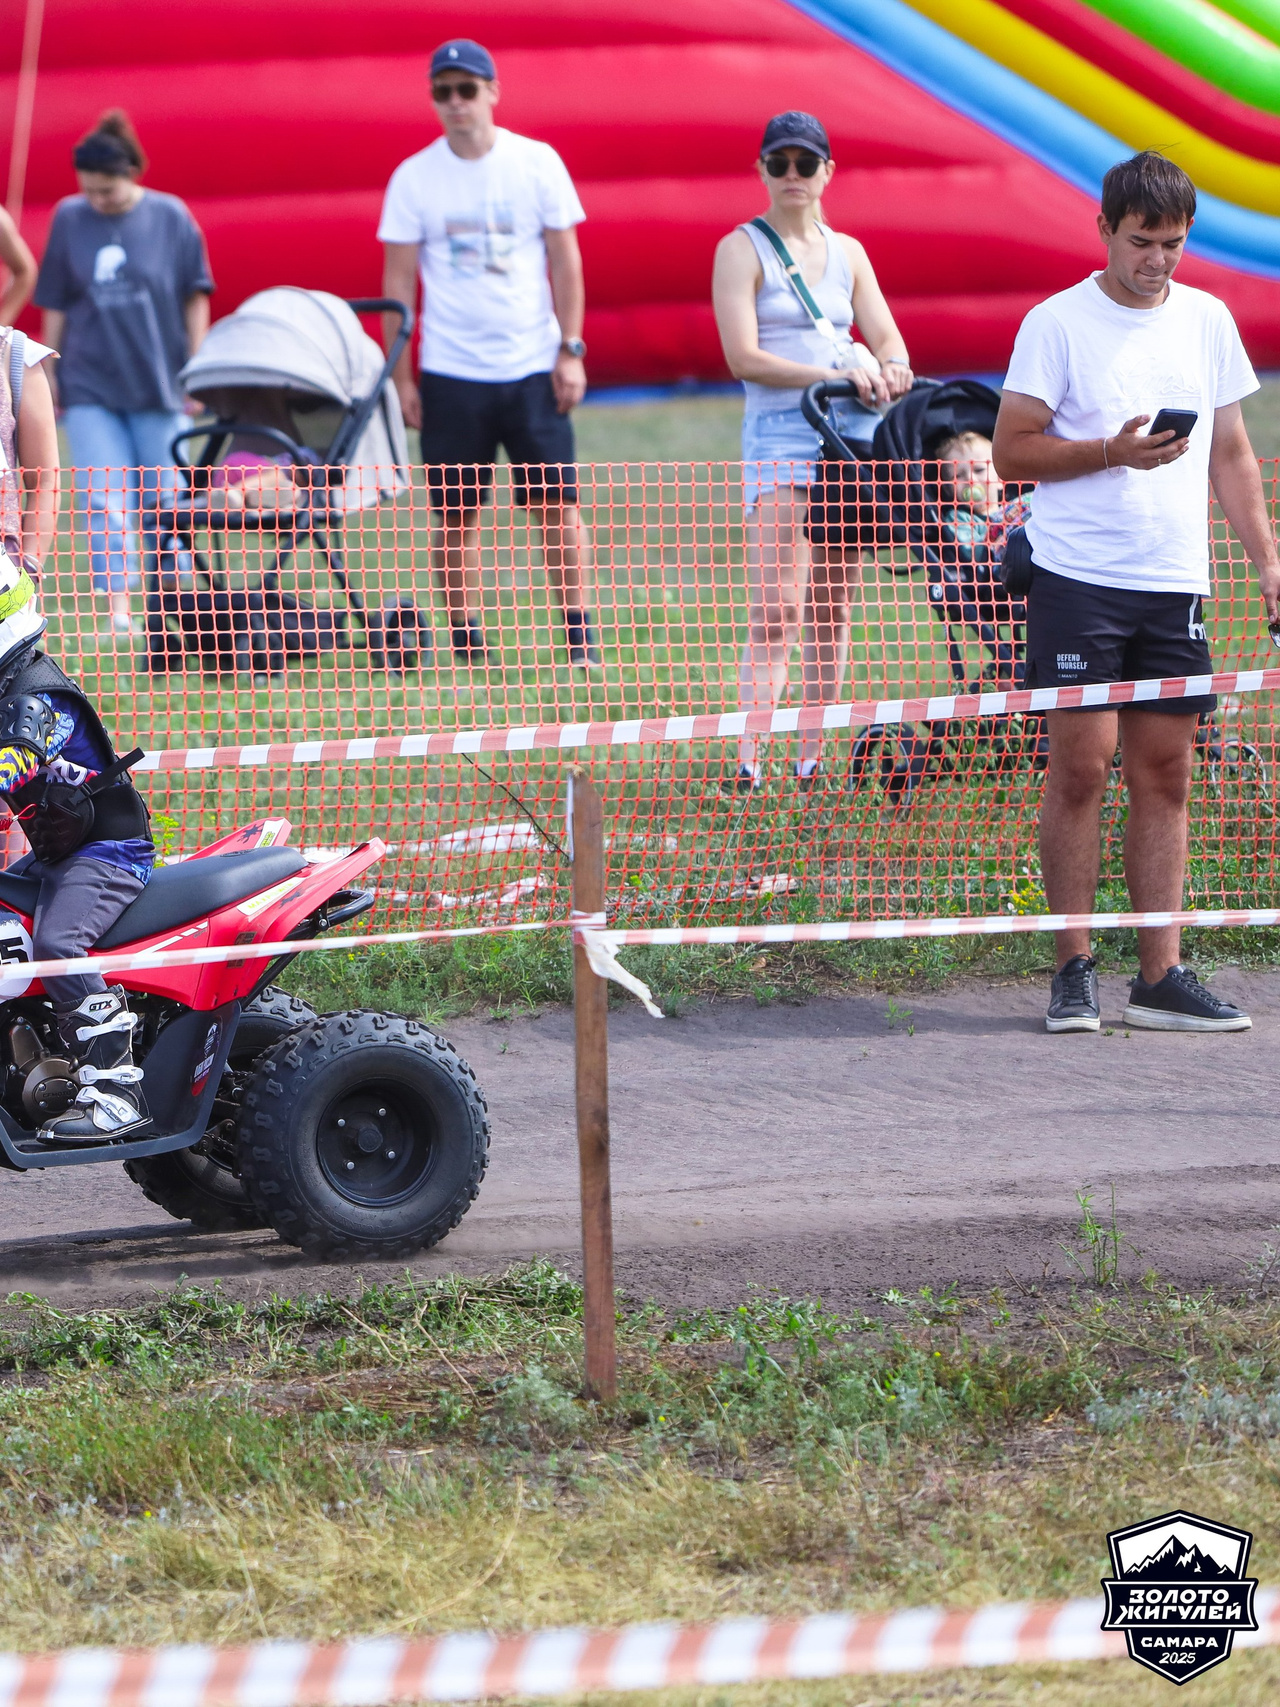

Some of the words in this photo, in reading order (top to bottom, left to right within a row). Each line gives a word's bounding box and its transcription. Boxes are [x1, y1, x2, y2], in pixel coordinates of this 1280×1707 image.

[1056, 653, 1081, 662] DEFEND
[1056, 661, 1088, 670] YOURSELF
[89, 999, 113, 1012] GTX
